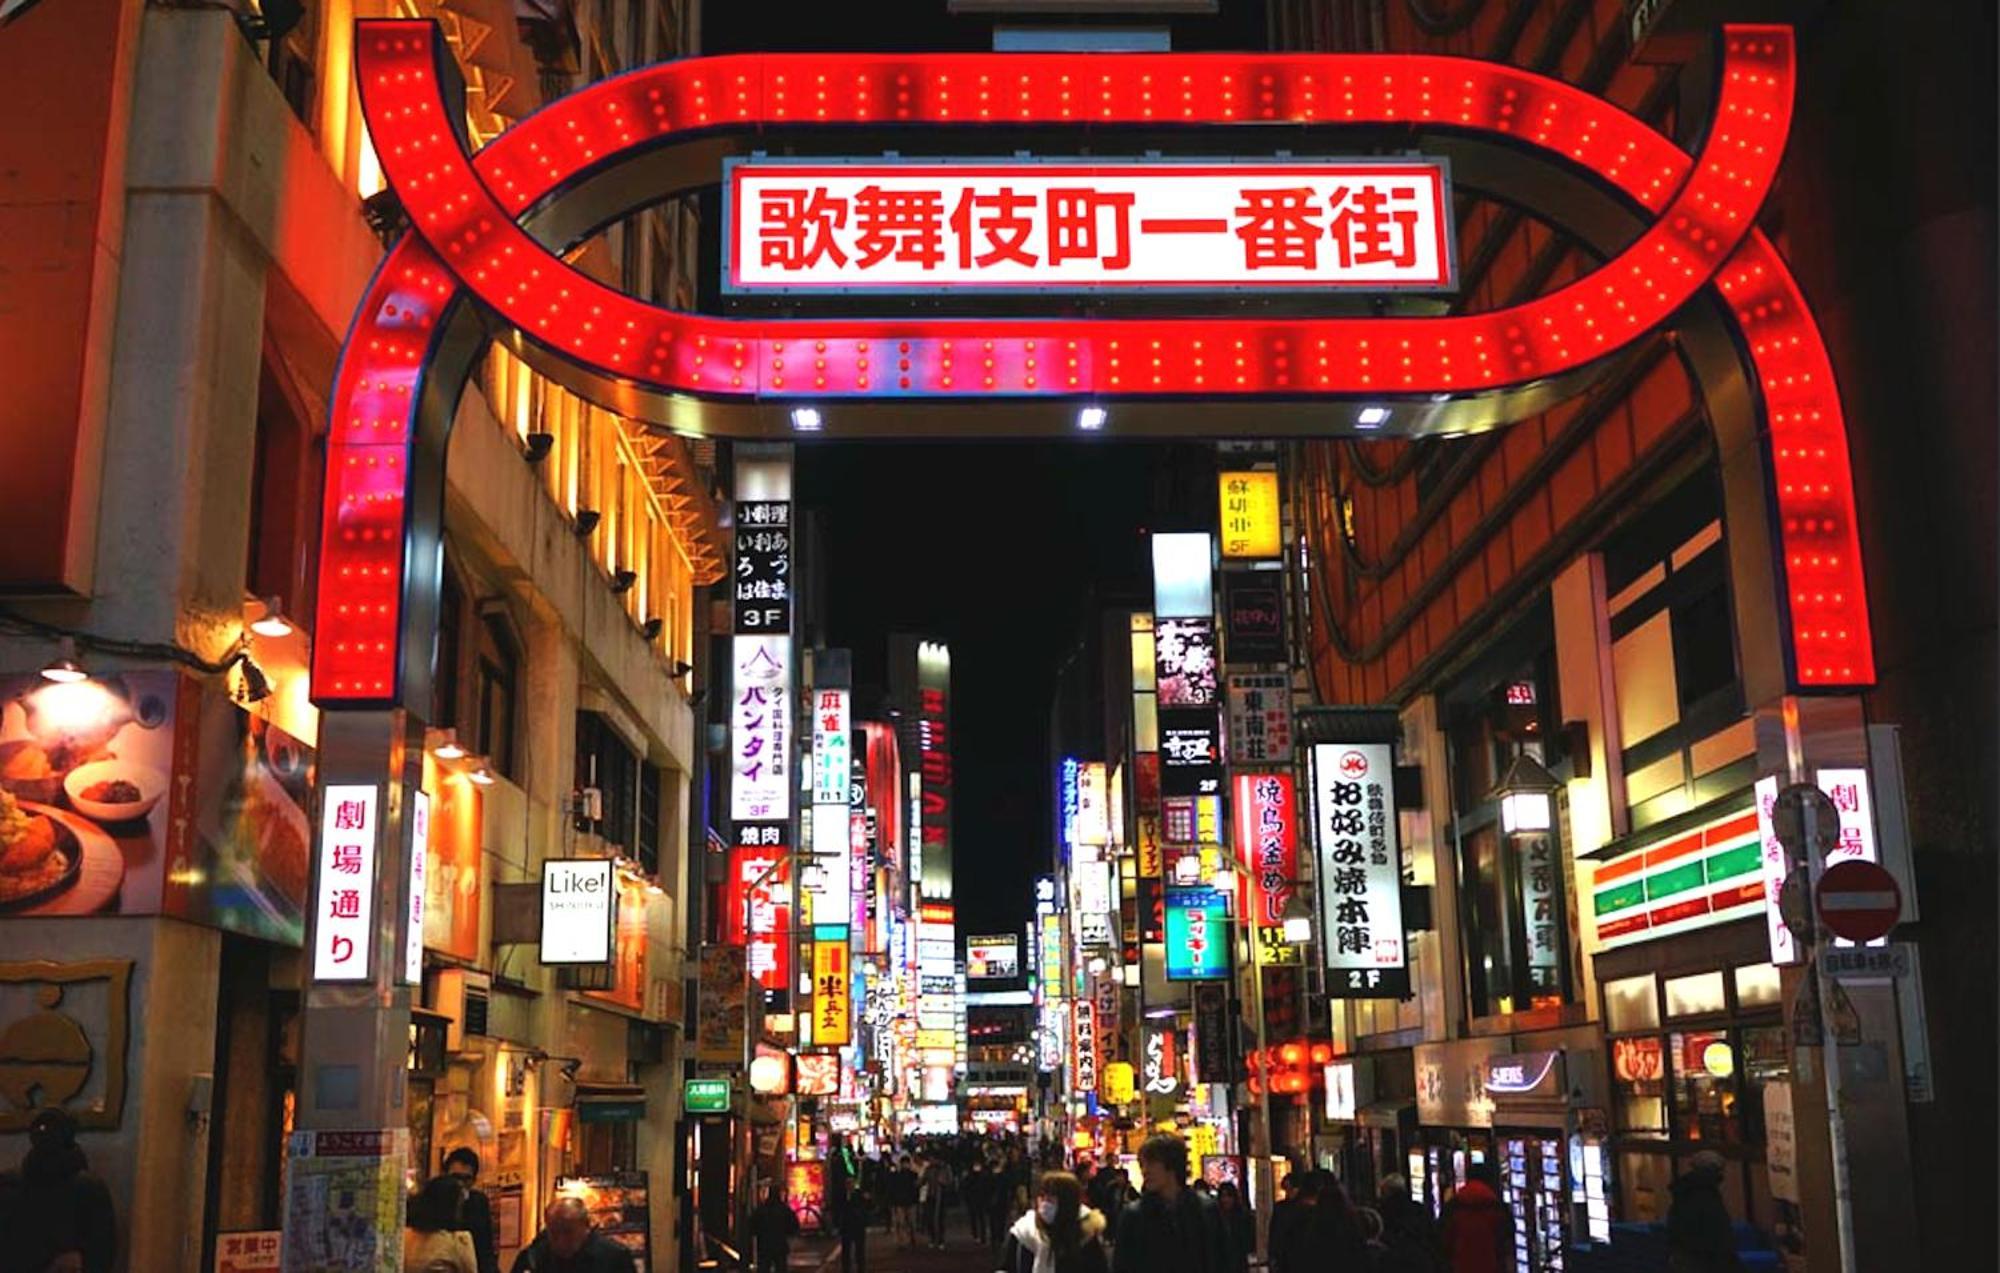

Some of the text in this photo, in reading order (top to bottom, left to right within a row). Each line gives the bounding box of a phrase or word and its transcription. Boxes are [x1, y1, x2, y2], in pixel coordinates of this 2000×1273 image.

[759, 186, 1420, 270] 歌舞伎町一番街
[744, 609, 782, 626] 3F
[819, 691, 842, 732] 麻雀
[1200, 779, 1219, 792] 2F
[750, 804, 770, 816] 3F
[1831, 784, 1863, 855] 劇場
[740, 827, 780, 845] 焼肉
[1256, 778, 1288, 921] 焼鳥釜めし
[330, 800, 365, 963] 劇場通り
[550, 870, 605, 893] Like!
[1264, 948, 1292, 962] 2F
[1349, 971, 1380, 989] 2F
